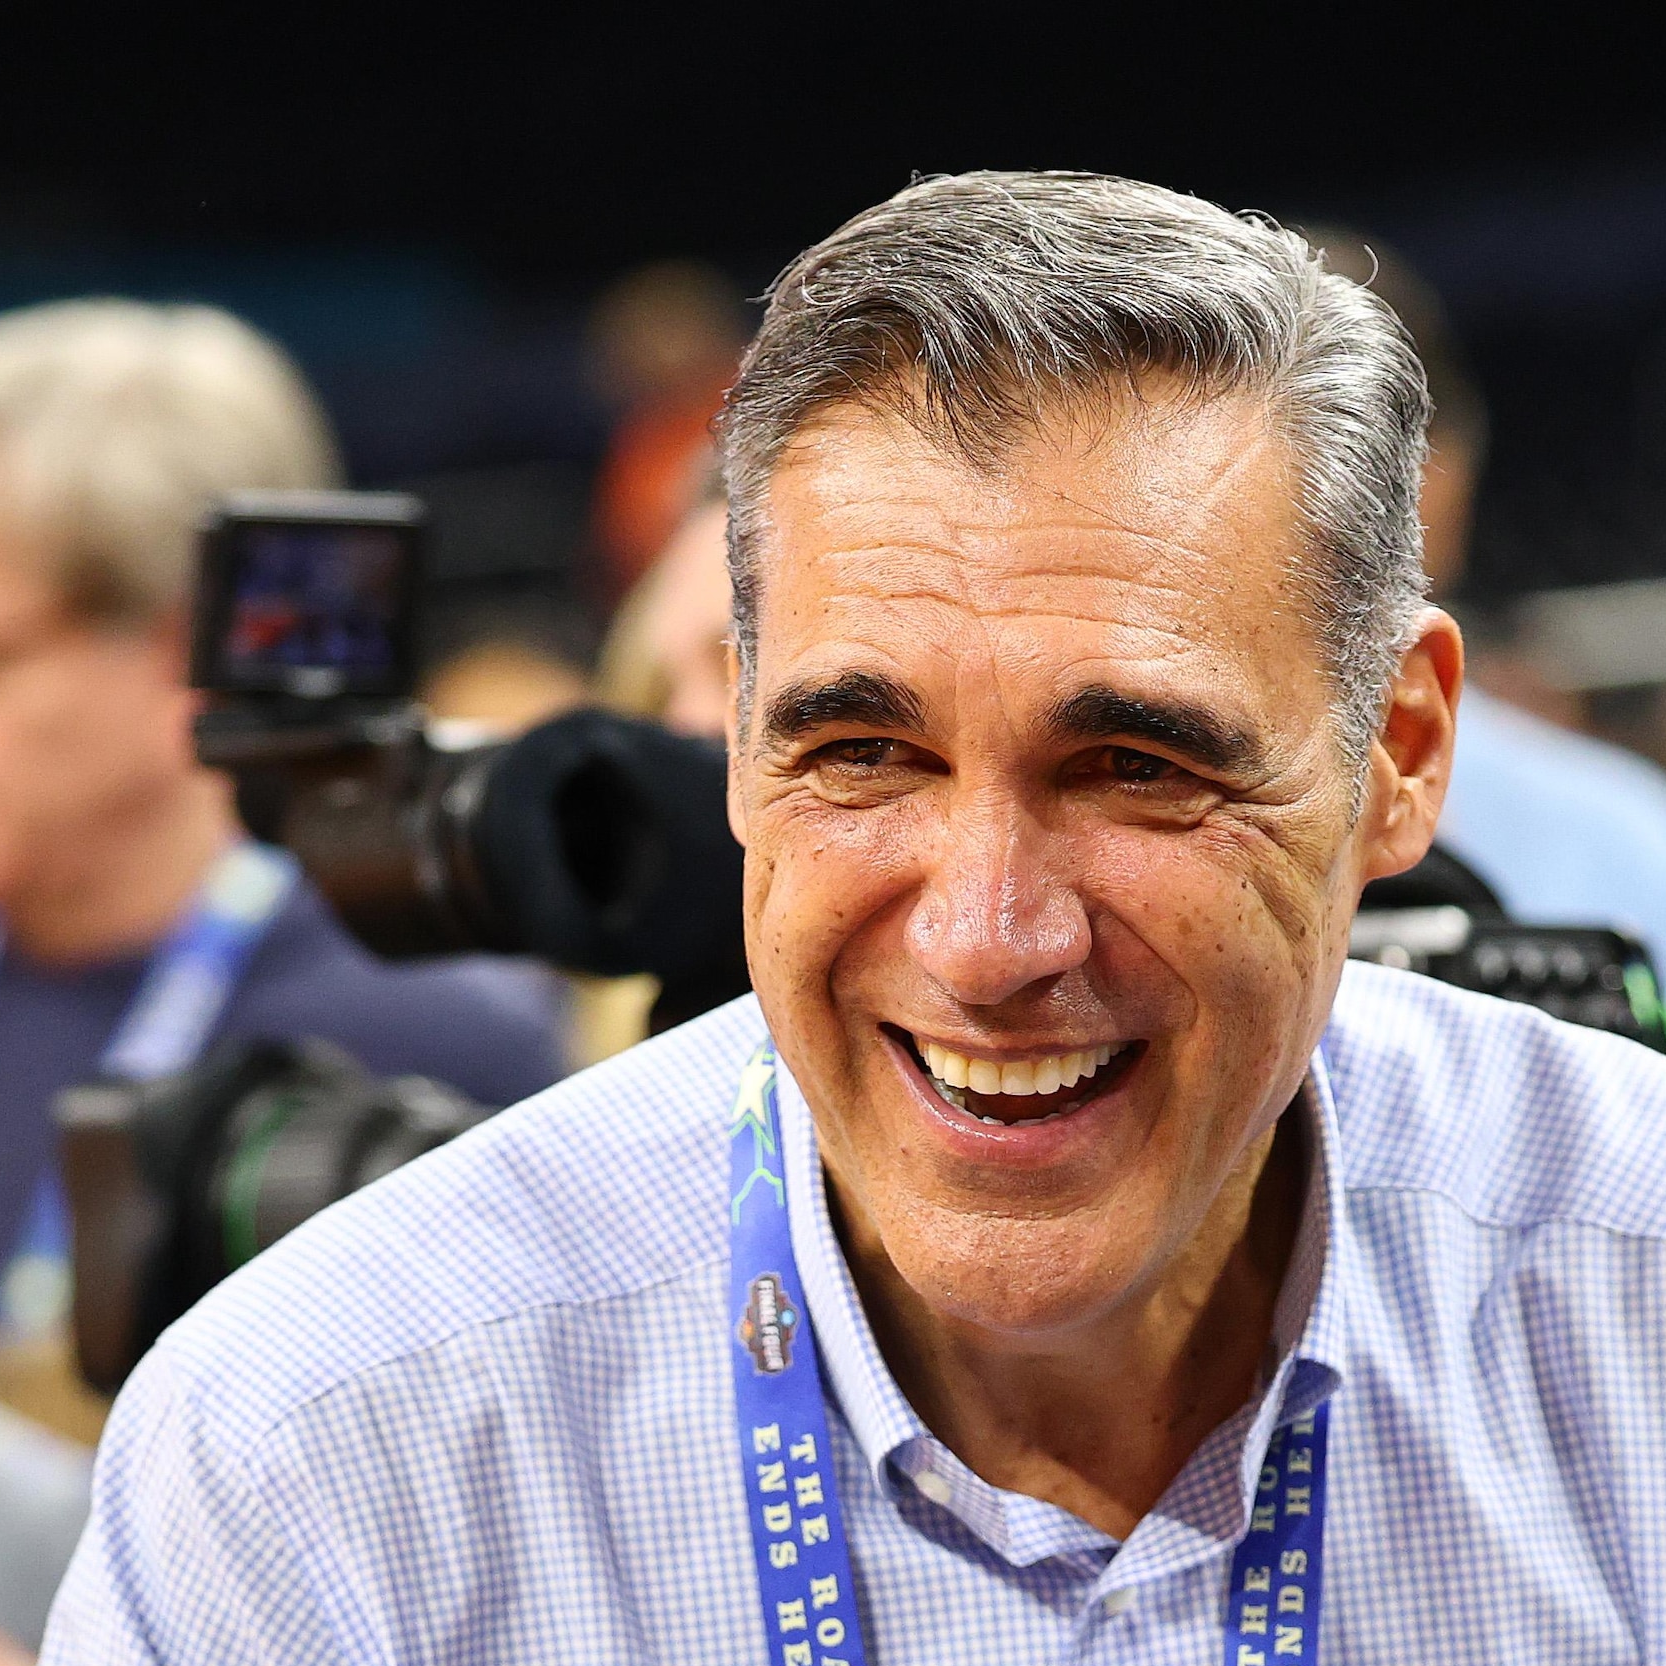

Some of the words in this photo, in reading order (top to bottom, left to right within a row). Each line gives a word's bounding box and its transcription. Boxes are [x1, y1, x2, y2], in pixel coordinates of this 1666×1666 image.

[752, 1423, 798, 1568] ENDS
[789, 1434, 831, 1545] THE
[1251, 1430, 1284, 1533] RO
[1285, 1406, 1317, 1516] HER
